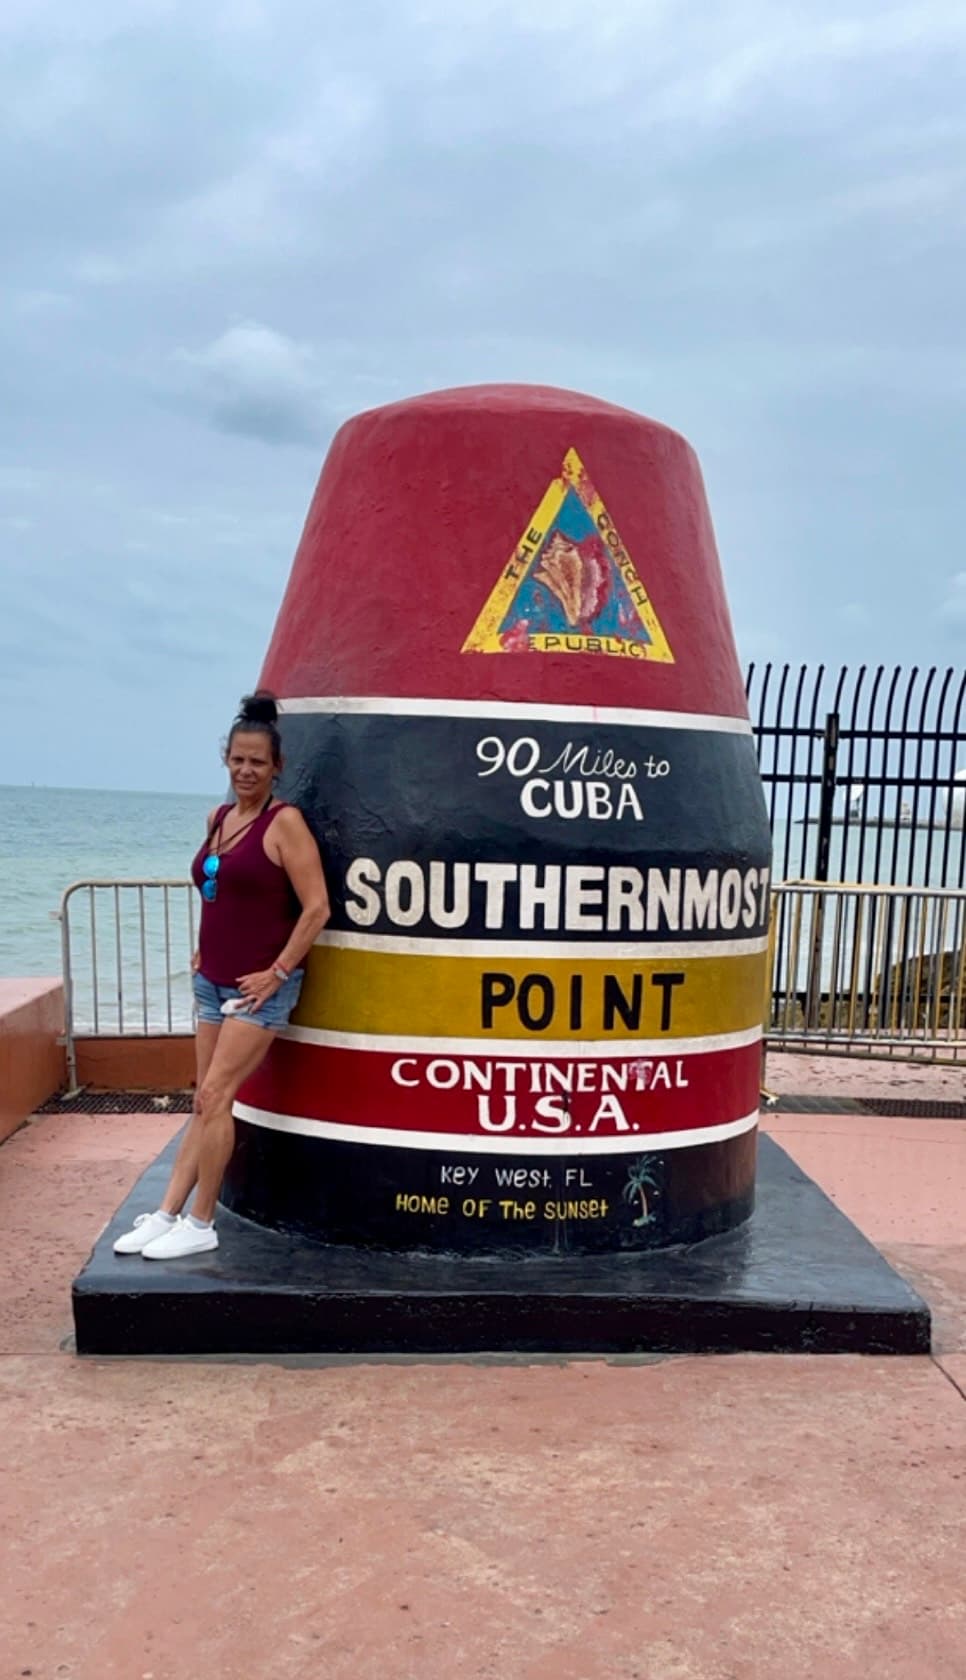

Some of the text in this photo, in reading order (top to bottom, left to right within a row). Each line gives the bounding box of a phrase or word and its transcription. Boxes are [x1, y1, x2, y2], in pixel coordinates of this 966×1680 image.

[505, 527, 542, 581] THE
[598, 513, 648, 606] CONCH
[527, 635, 643, 657] EPUBLIC
[476, 736, 671, 779] 90 Miles to
[520, 778, 644, 820] CUBA
[345, 857, 770, 931] SOUTHERNMOST
[481, 972, 685, 1031] POINT
[390, 1058, 689, 1092] CONTINENTAL
[477, 1094, 641, 1133] U.S.A.
[565, 1168, 593, 1187] FL
[462, 1199, 492, 1219] OF
[499, 1200, 536, 1220] The
